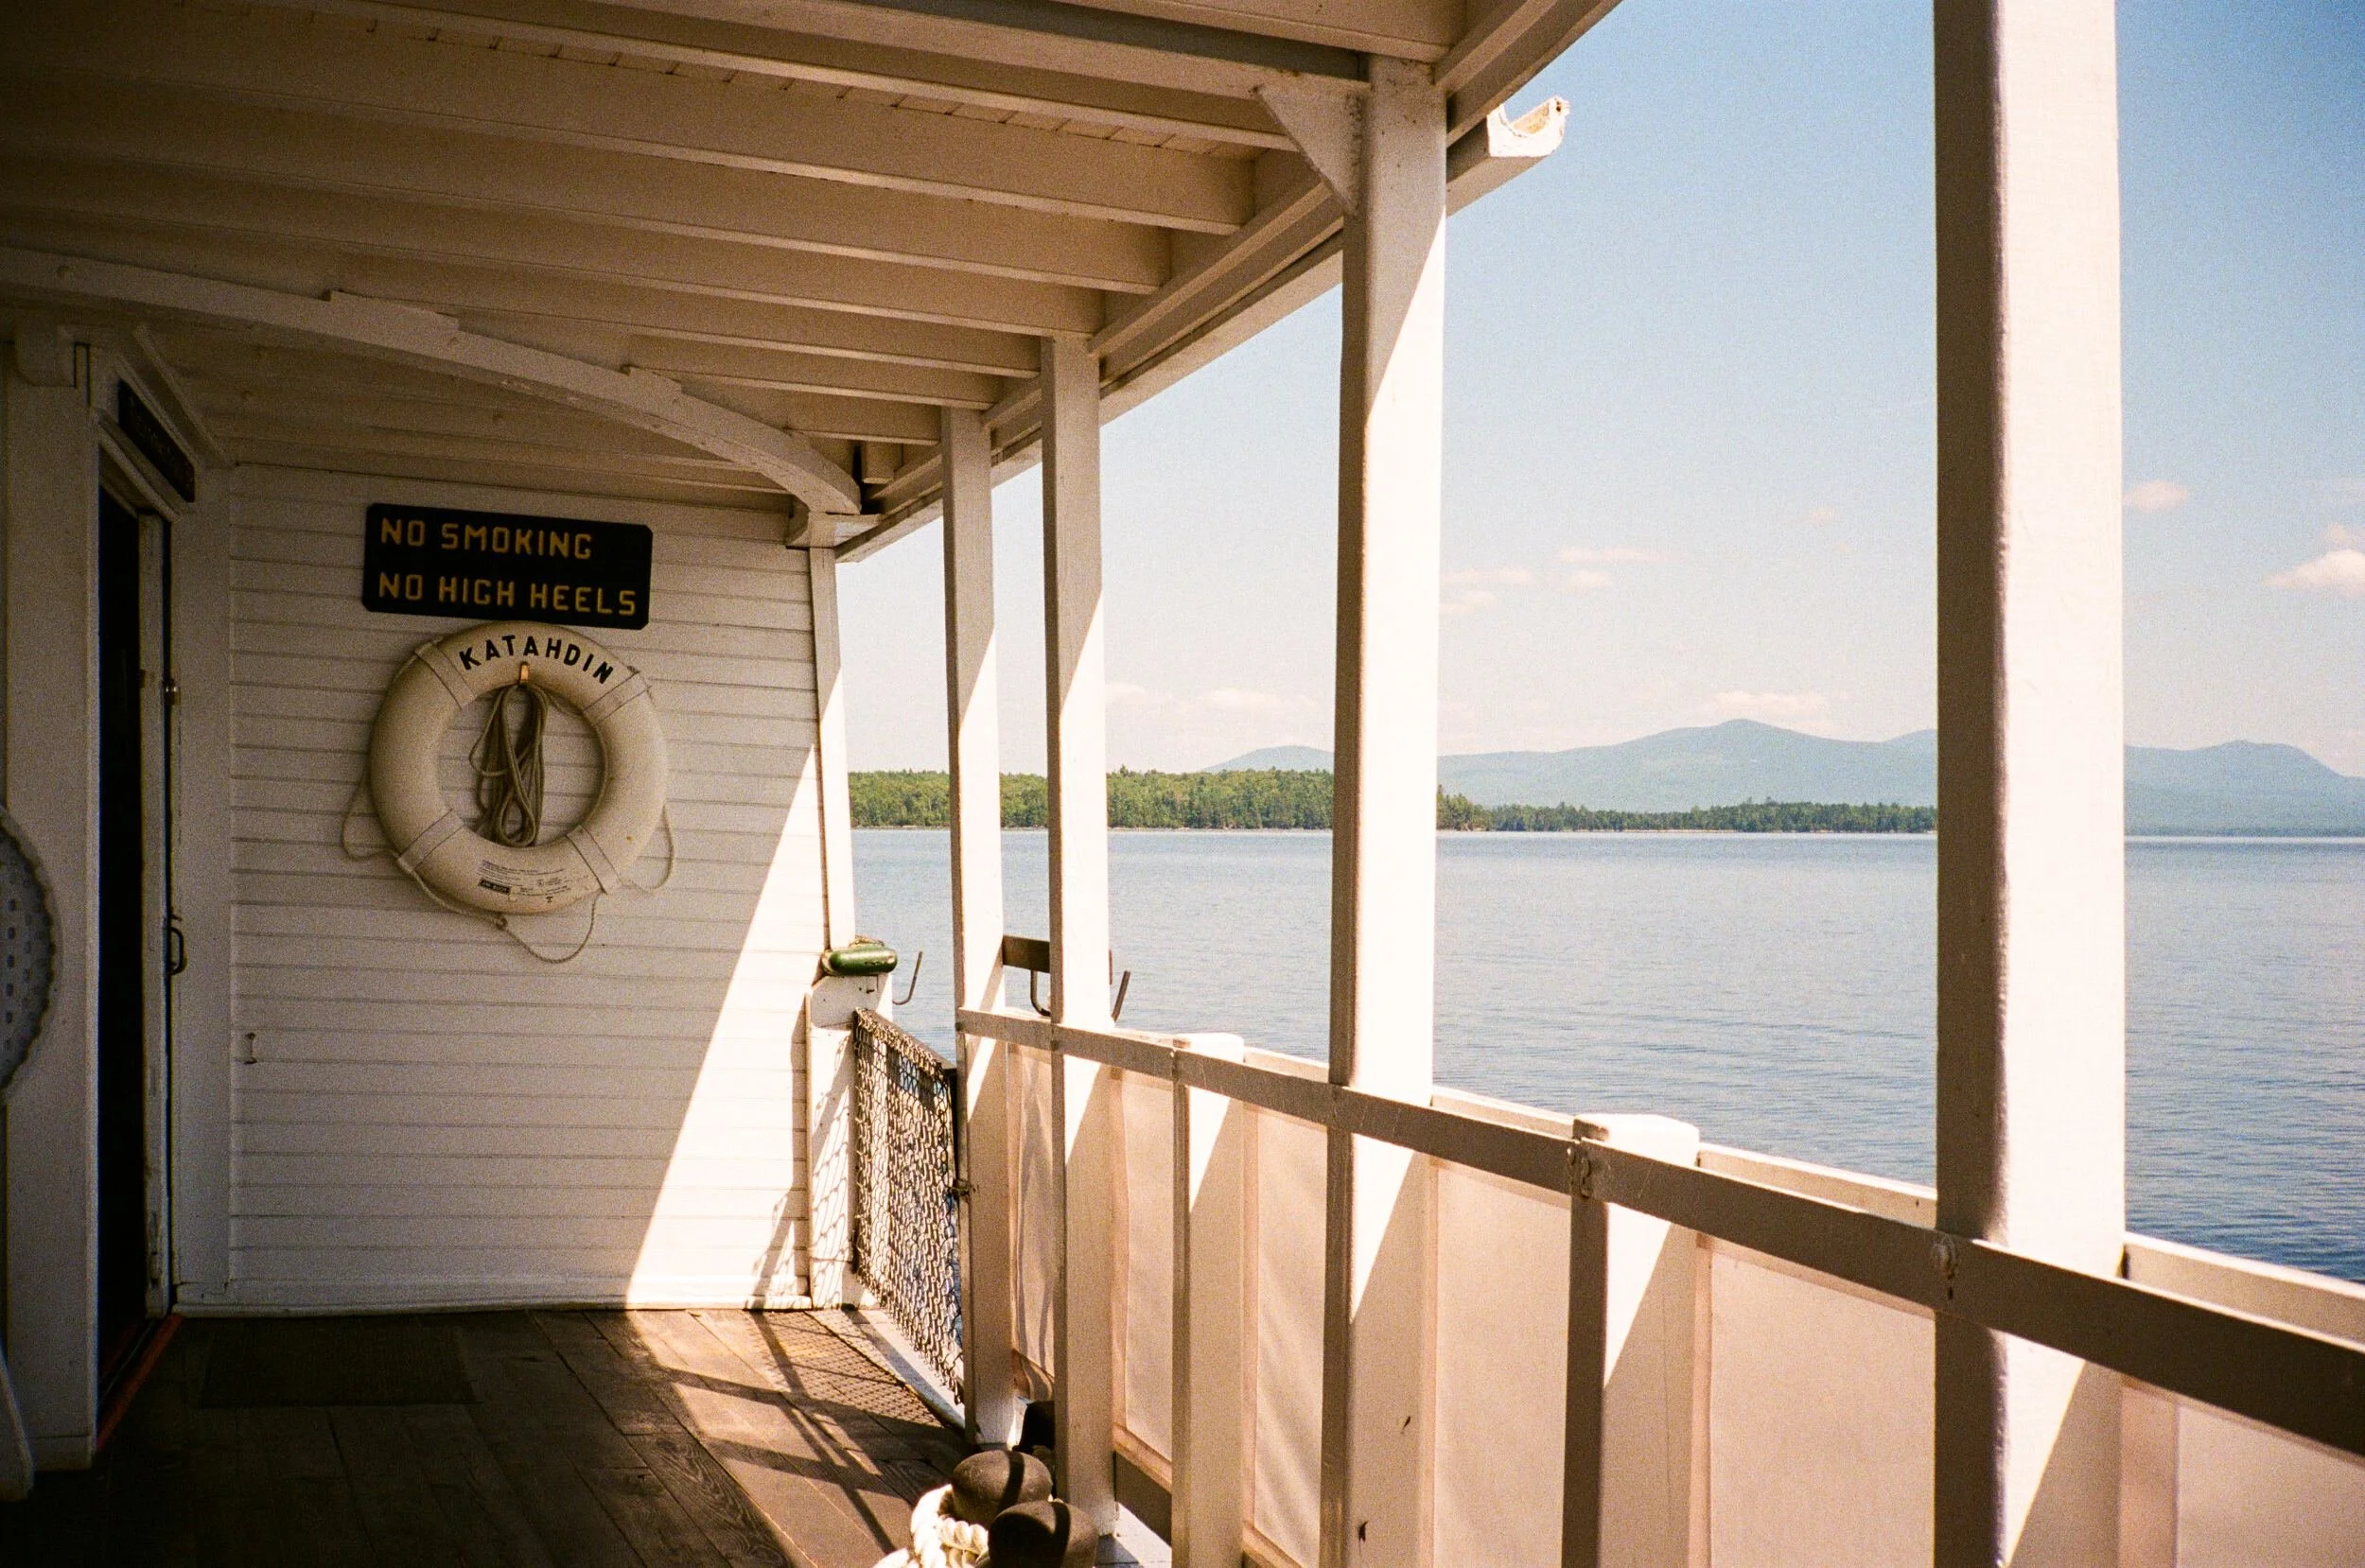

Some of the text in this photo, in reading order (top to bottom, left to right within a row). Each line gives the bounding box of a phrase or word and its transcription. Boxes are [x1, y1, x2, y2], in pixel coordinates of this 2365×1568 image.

[380, 517, 592, 560] NO SMOKING
[378, 572, 637, 616] NO HIGH HEELS
[459, 635, 614, 685] KATAHDIN
